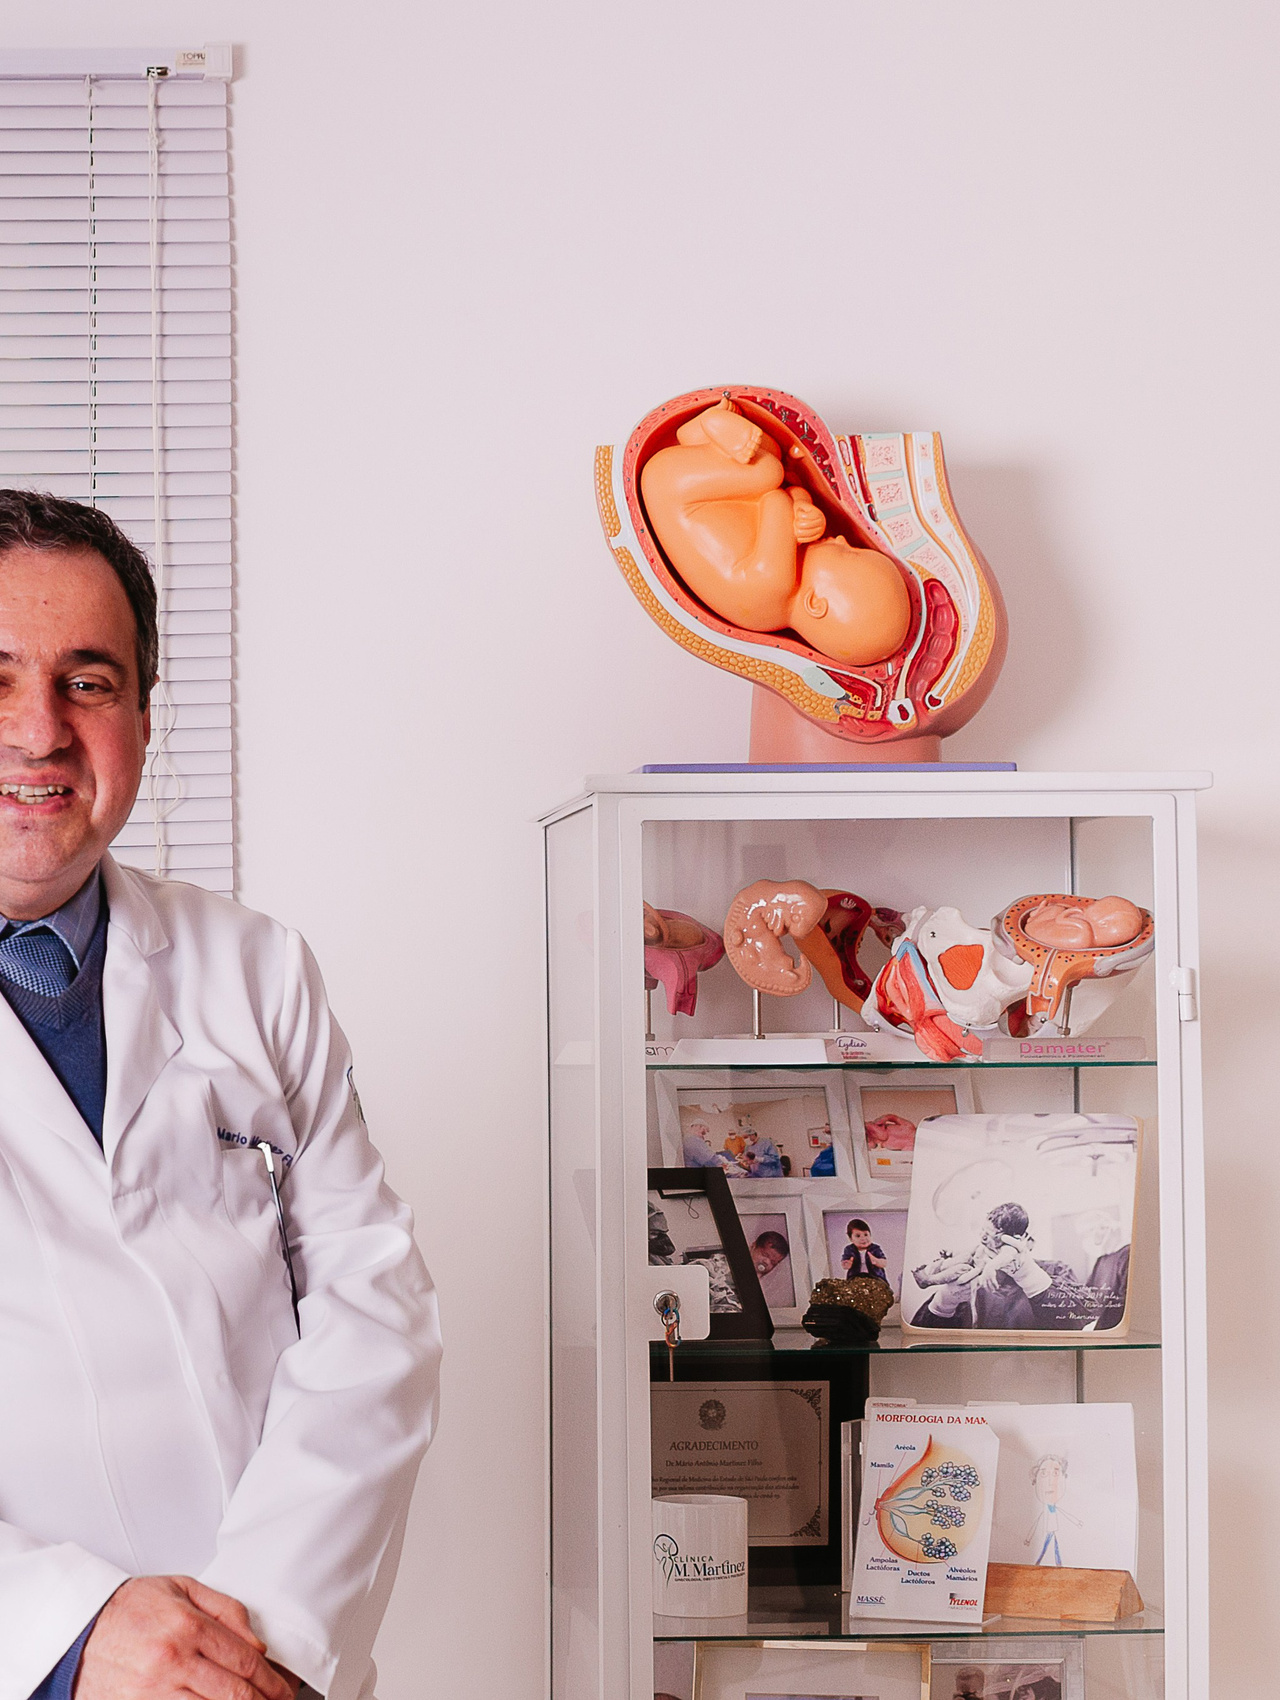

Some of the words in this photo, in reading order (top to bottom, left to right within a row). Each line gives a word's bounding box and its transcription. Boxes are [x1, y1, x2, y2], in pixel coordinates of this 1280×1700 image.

[1020, 1042, 1106, 1054] Damater
[876, 1414, 944, 1424] MORFOLOGIA
[947, 1416, 962, 1424] DA
[670, 1441, 759, 1451] AGRADECIMENTO
[675, 1563, 690, 1577] M.
[694, 1560, 745, 1577] Martinez
[949, 1598, 978, 1607] TYLENOL
